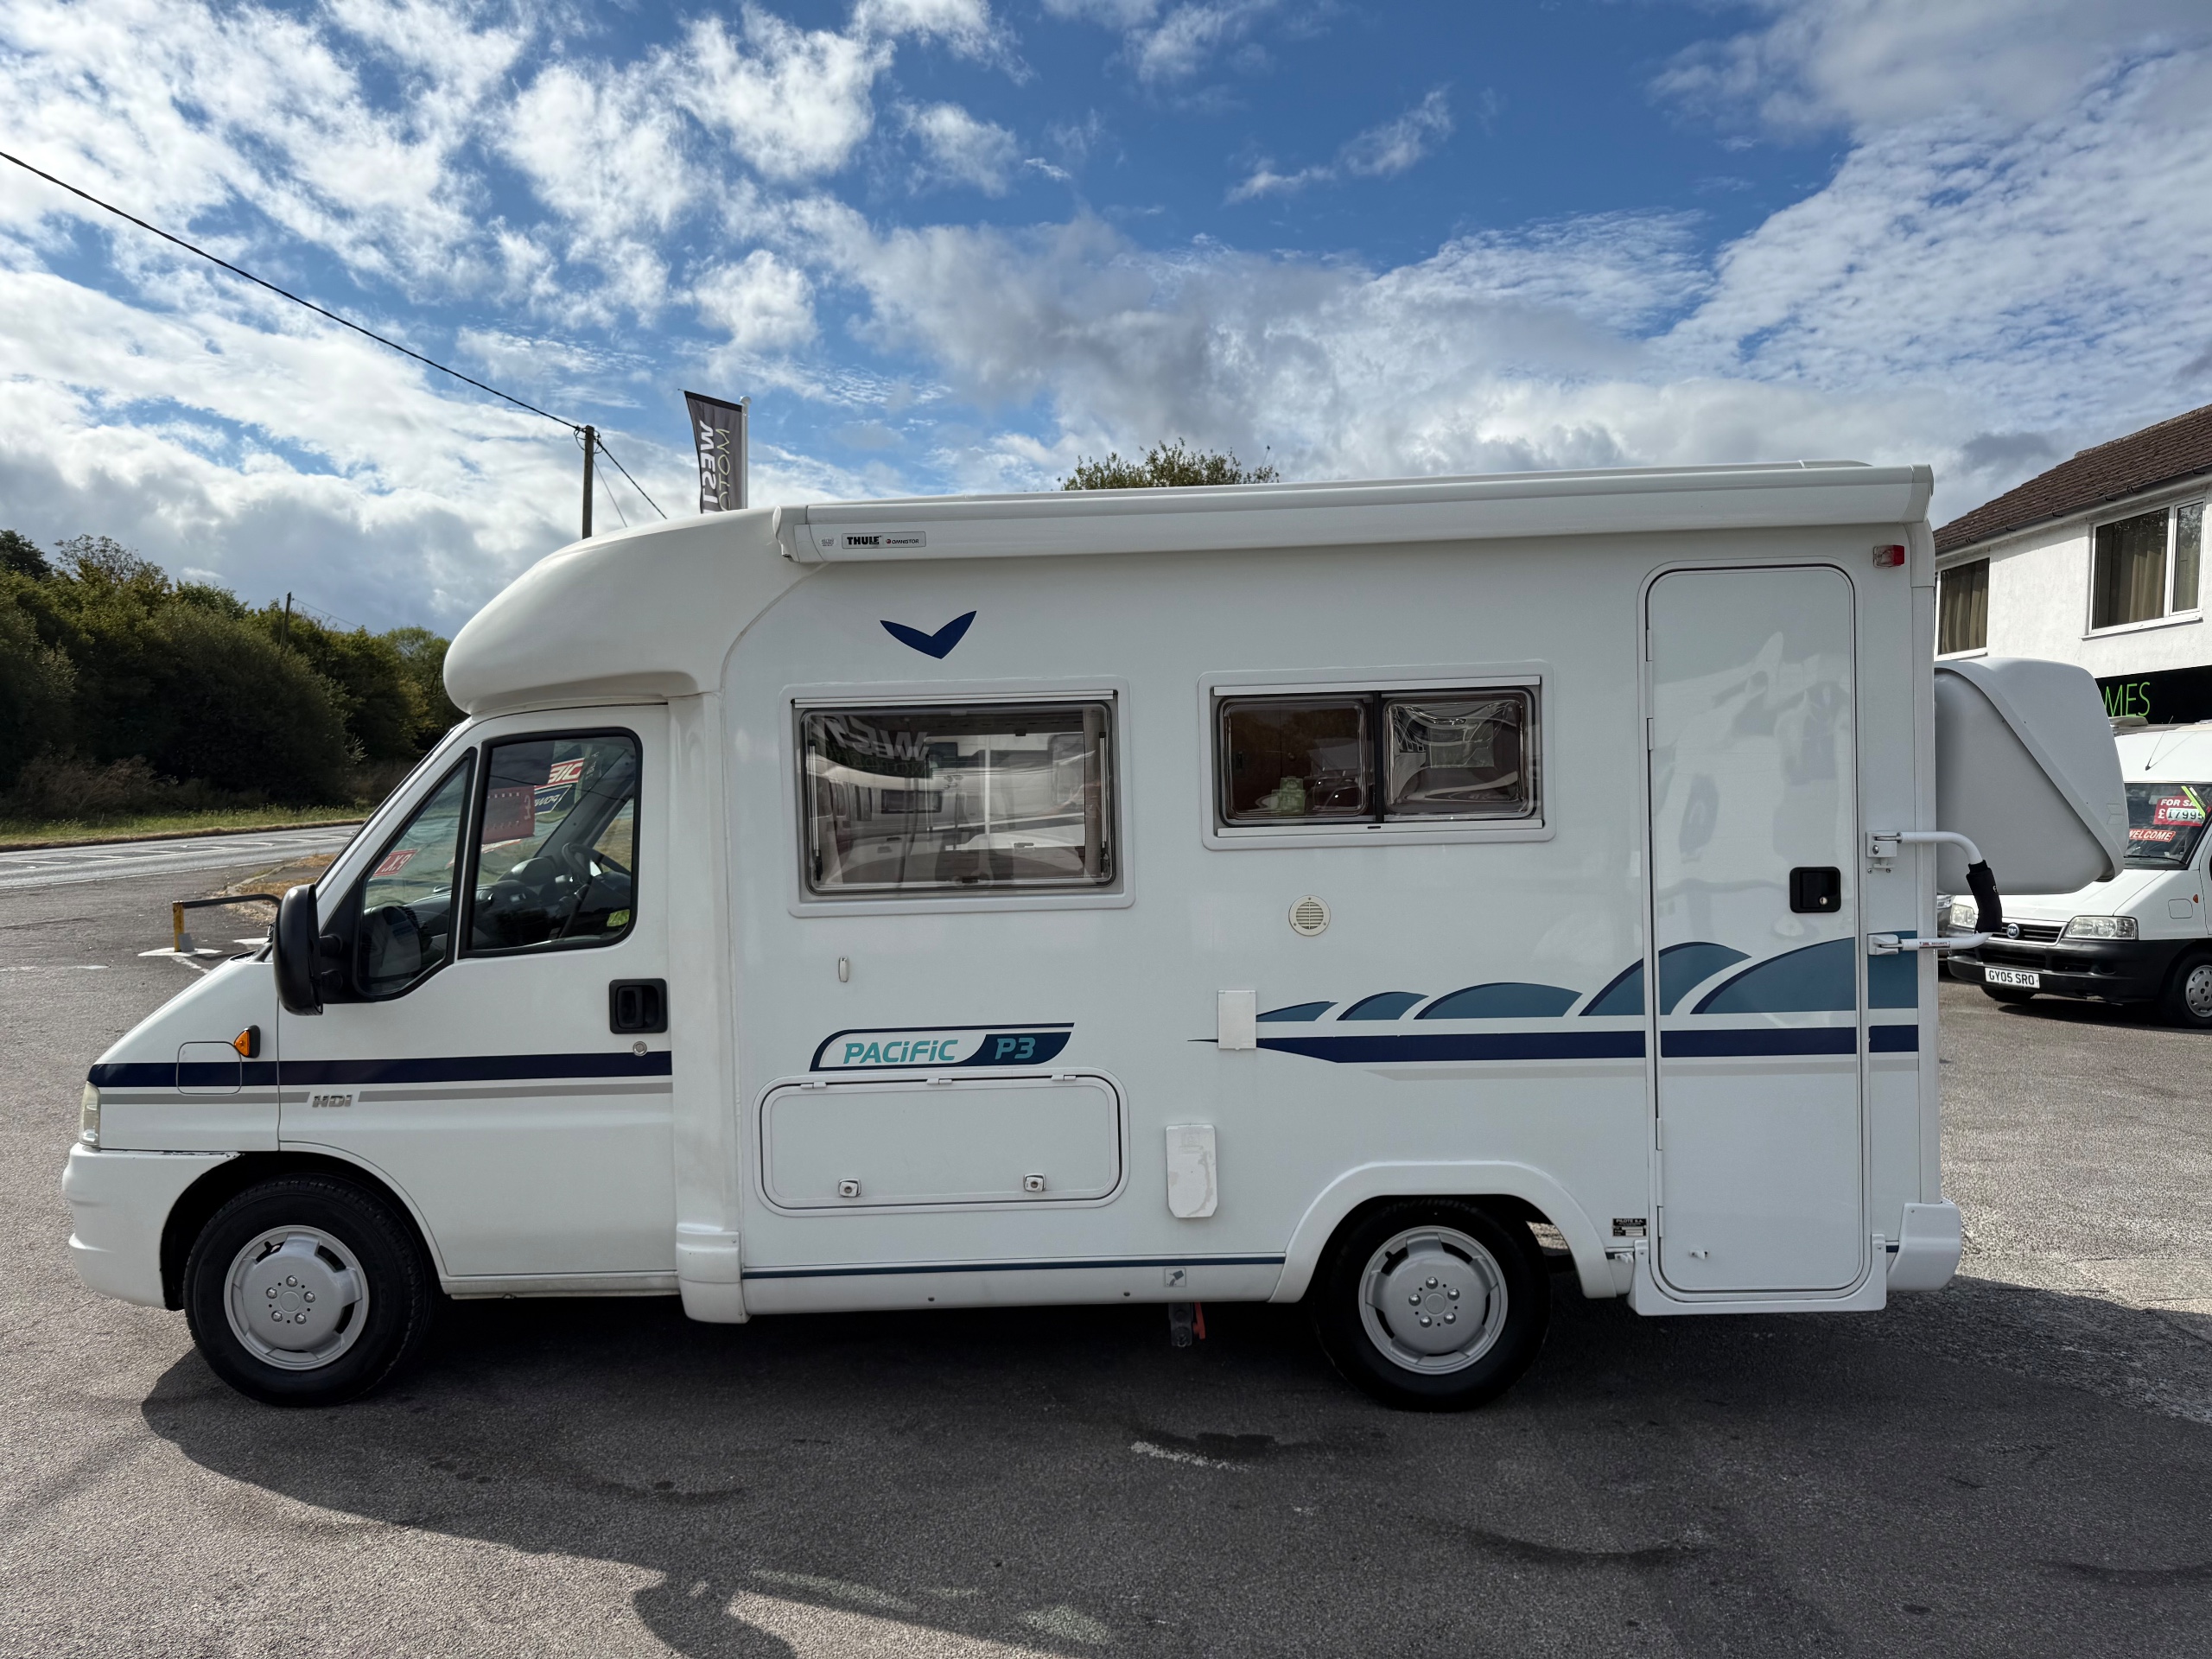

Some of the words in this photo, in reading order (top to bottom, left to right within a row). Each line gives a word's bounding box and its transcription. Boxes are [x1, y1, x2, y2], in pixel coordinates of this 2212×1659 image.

[847, 537, 879, 545] THULE
[2105, 682, 2151, 717] MES
[1989, 969, 2013, 982] GY05
[2015, 973, 2035, 985] SRO
[995, 1037, 1036, 1060] P3
